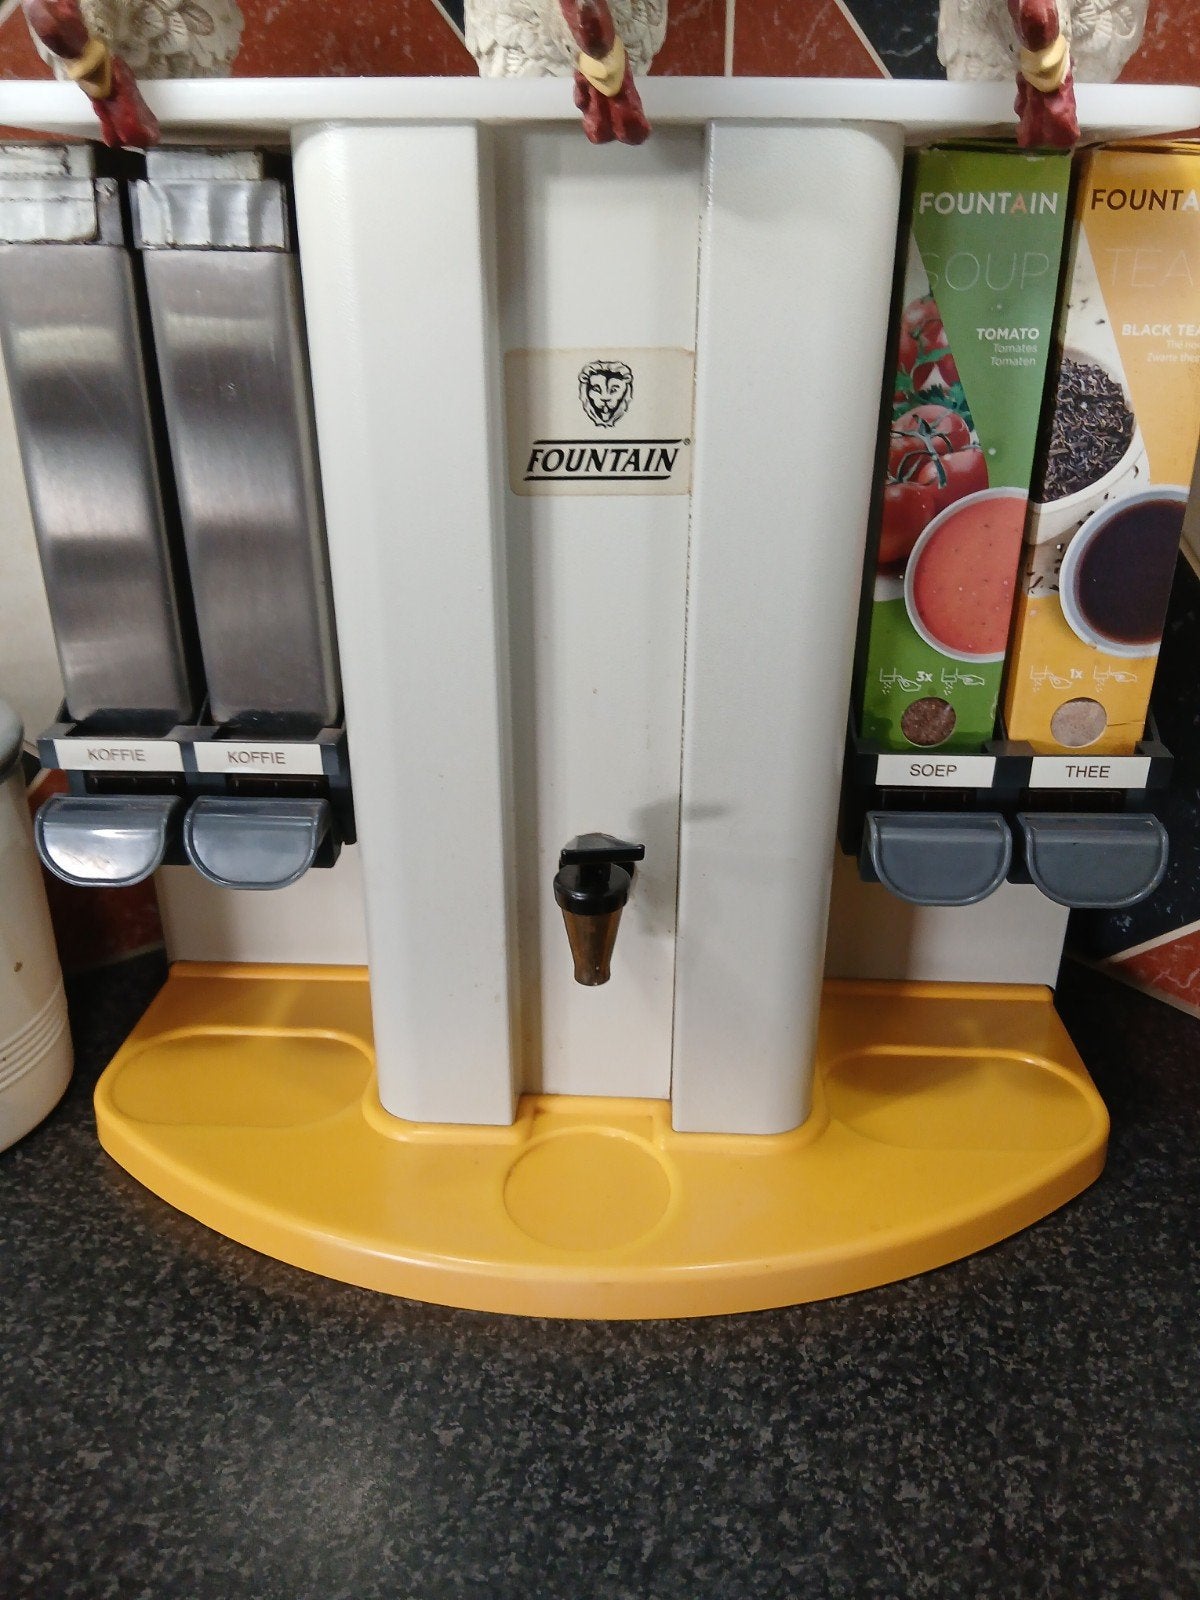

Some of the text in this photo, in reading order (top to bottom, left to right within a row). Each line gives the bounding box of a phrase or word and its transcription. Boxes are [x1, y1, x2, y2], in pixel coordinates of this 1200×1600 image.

[918, 191, 1059, 216] FOUNTAIN
[1104, 248, 1194, 289] TEA
[976, 327, 1040, 341] TOMATO
[1121, 323, 1172, 337] BLACK
[993, 343, 1038, 354] Tomates
[990, 357, 1036, 367] Tomaten
[526, 448, 679, 473] FOUNTAIN
[915, 670, 933, 684] 3x
[1070, 668, 1084, 681] 1x
[87, 748, 146, 763] KOFFIE
[227, 750, 286, 765] KOFFIE
[909, 763, 957, 778] SOEP
[1065, 765, 1111, 779] THEE
